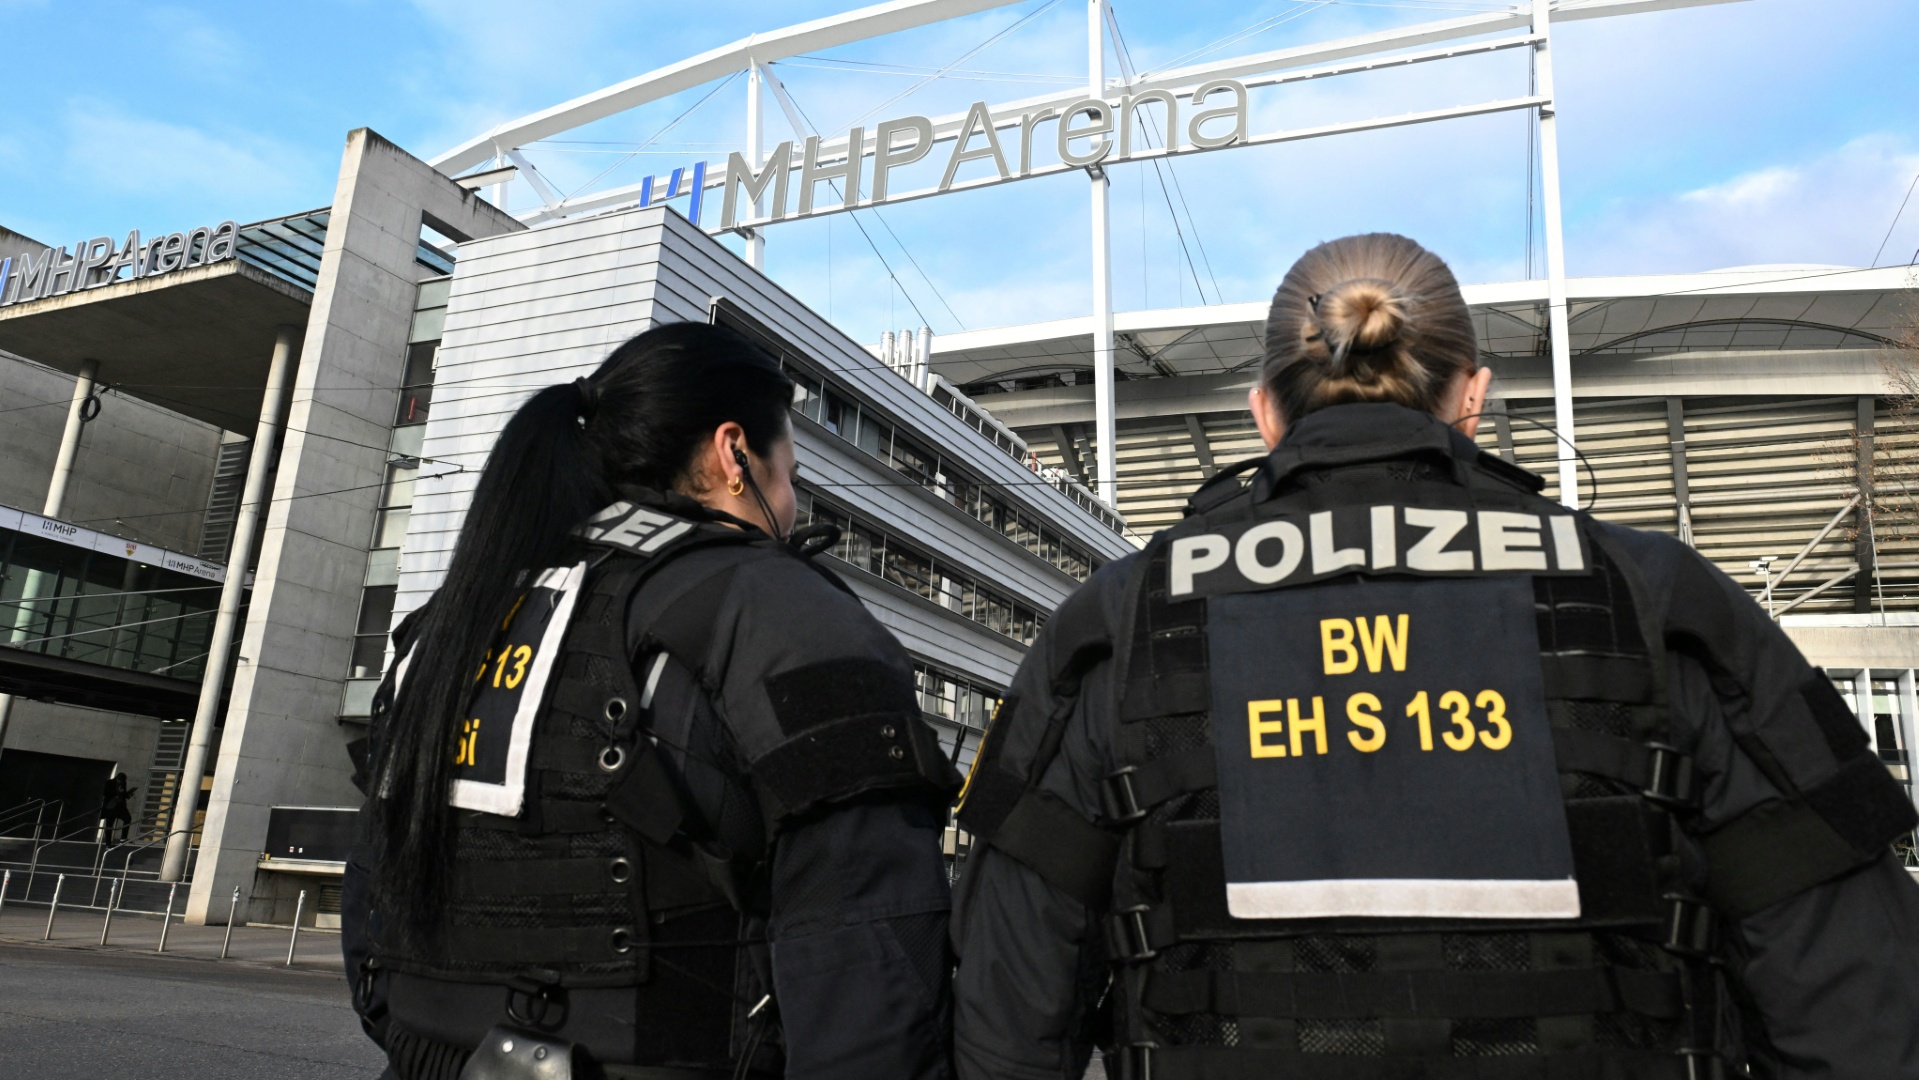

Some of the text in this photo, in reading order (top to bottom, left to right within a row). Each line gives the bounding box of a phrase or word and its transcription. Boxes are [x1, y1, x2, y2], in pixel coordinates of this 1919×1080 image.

[719, 77, 1249, 230] MHPArena
[53, 523, 77, 536] MHP
[1170, 505, 1585, 597] POLIZEI
[1320, 613, 1410, 675] BW
[1247, 689, 1513, 759] EH S 133
